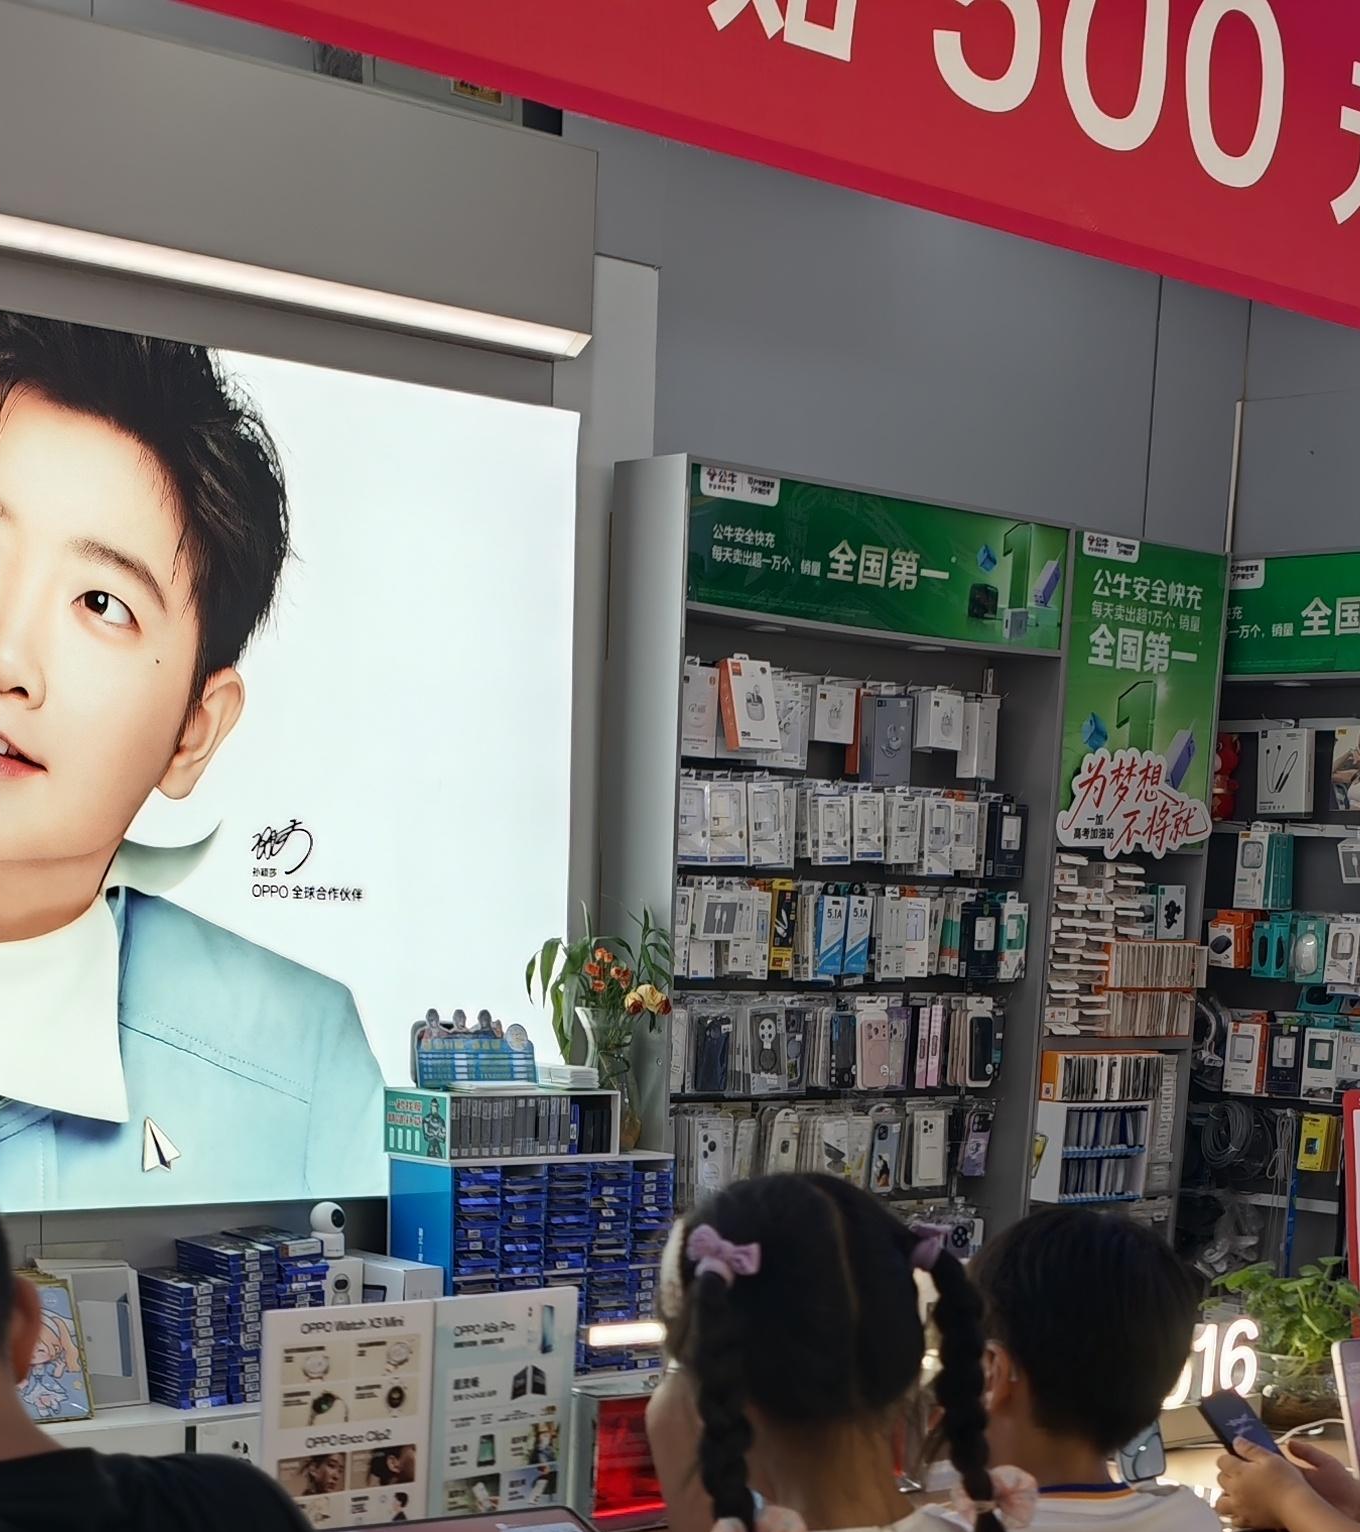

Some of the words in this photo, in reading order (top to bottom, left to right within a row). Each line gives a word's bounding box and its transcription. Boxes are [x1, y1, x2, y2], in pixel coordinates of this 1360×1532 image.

[712, 523, 776, 549] 公牛安全快充
[827, 539, 950, 592] 全国第一
[1092, 569, 1204, 611] 公牛安全快充
[1088, 624, 1198, 674] 全国第一
[1062, 756, 1180, 830] 为梦想
[1087, 814, 1104, 826] 一加
[1110, 800, 1209, 852] 不将就
[1073, 827, 1115, 840] 高考加油站
[252, 884, 289, 898] OPPO
[292, 885, 363, 901] 全球合作伙伴
[827, 908, 842, 920] 5.1A
[853, 907, 868, 919] 5.1A
[300, 1321, 333, 1335] OPPO
[453, 1323, 481, 1337] OPPO
[305, 1434, 338, 1449] OPPO
